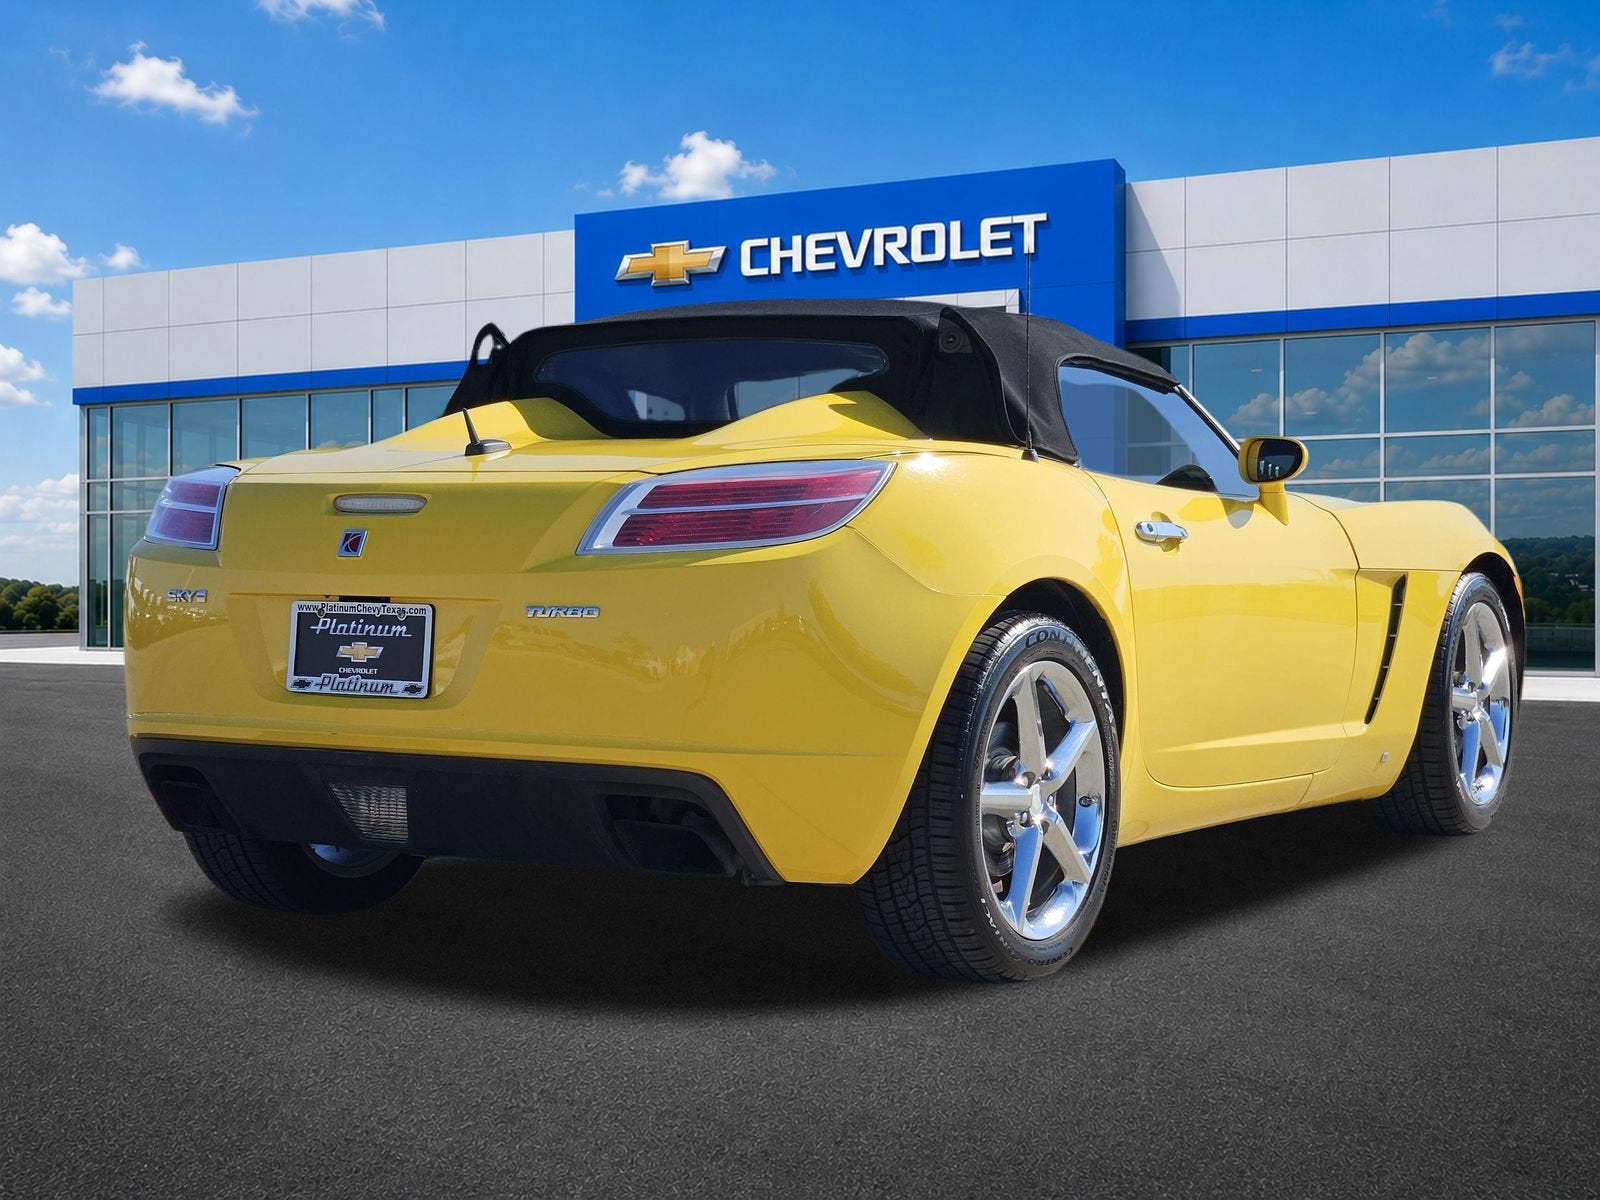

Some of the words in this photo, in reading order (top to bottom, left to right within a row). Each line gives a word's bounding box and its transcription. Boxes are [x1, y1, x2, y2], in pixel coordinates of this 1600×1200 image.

[740, 212, 1048, 278] CHEVROLET
[297, 602, 427, 616] www.PlatinumChevyTexas.com
[526, 606, 600, 618] TURBO
[310, 618, 413, 637] Platinum
[338, 667, 378, 675] CHEVROLET
[314, 675, 400, 694] Platinum
